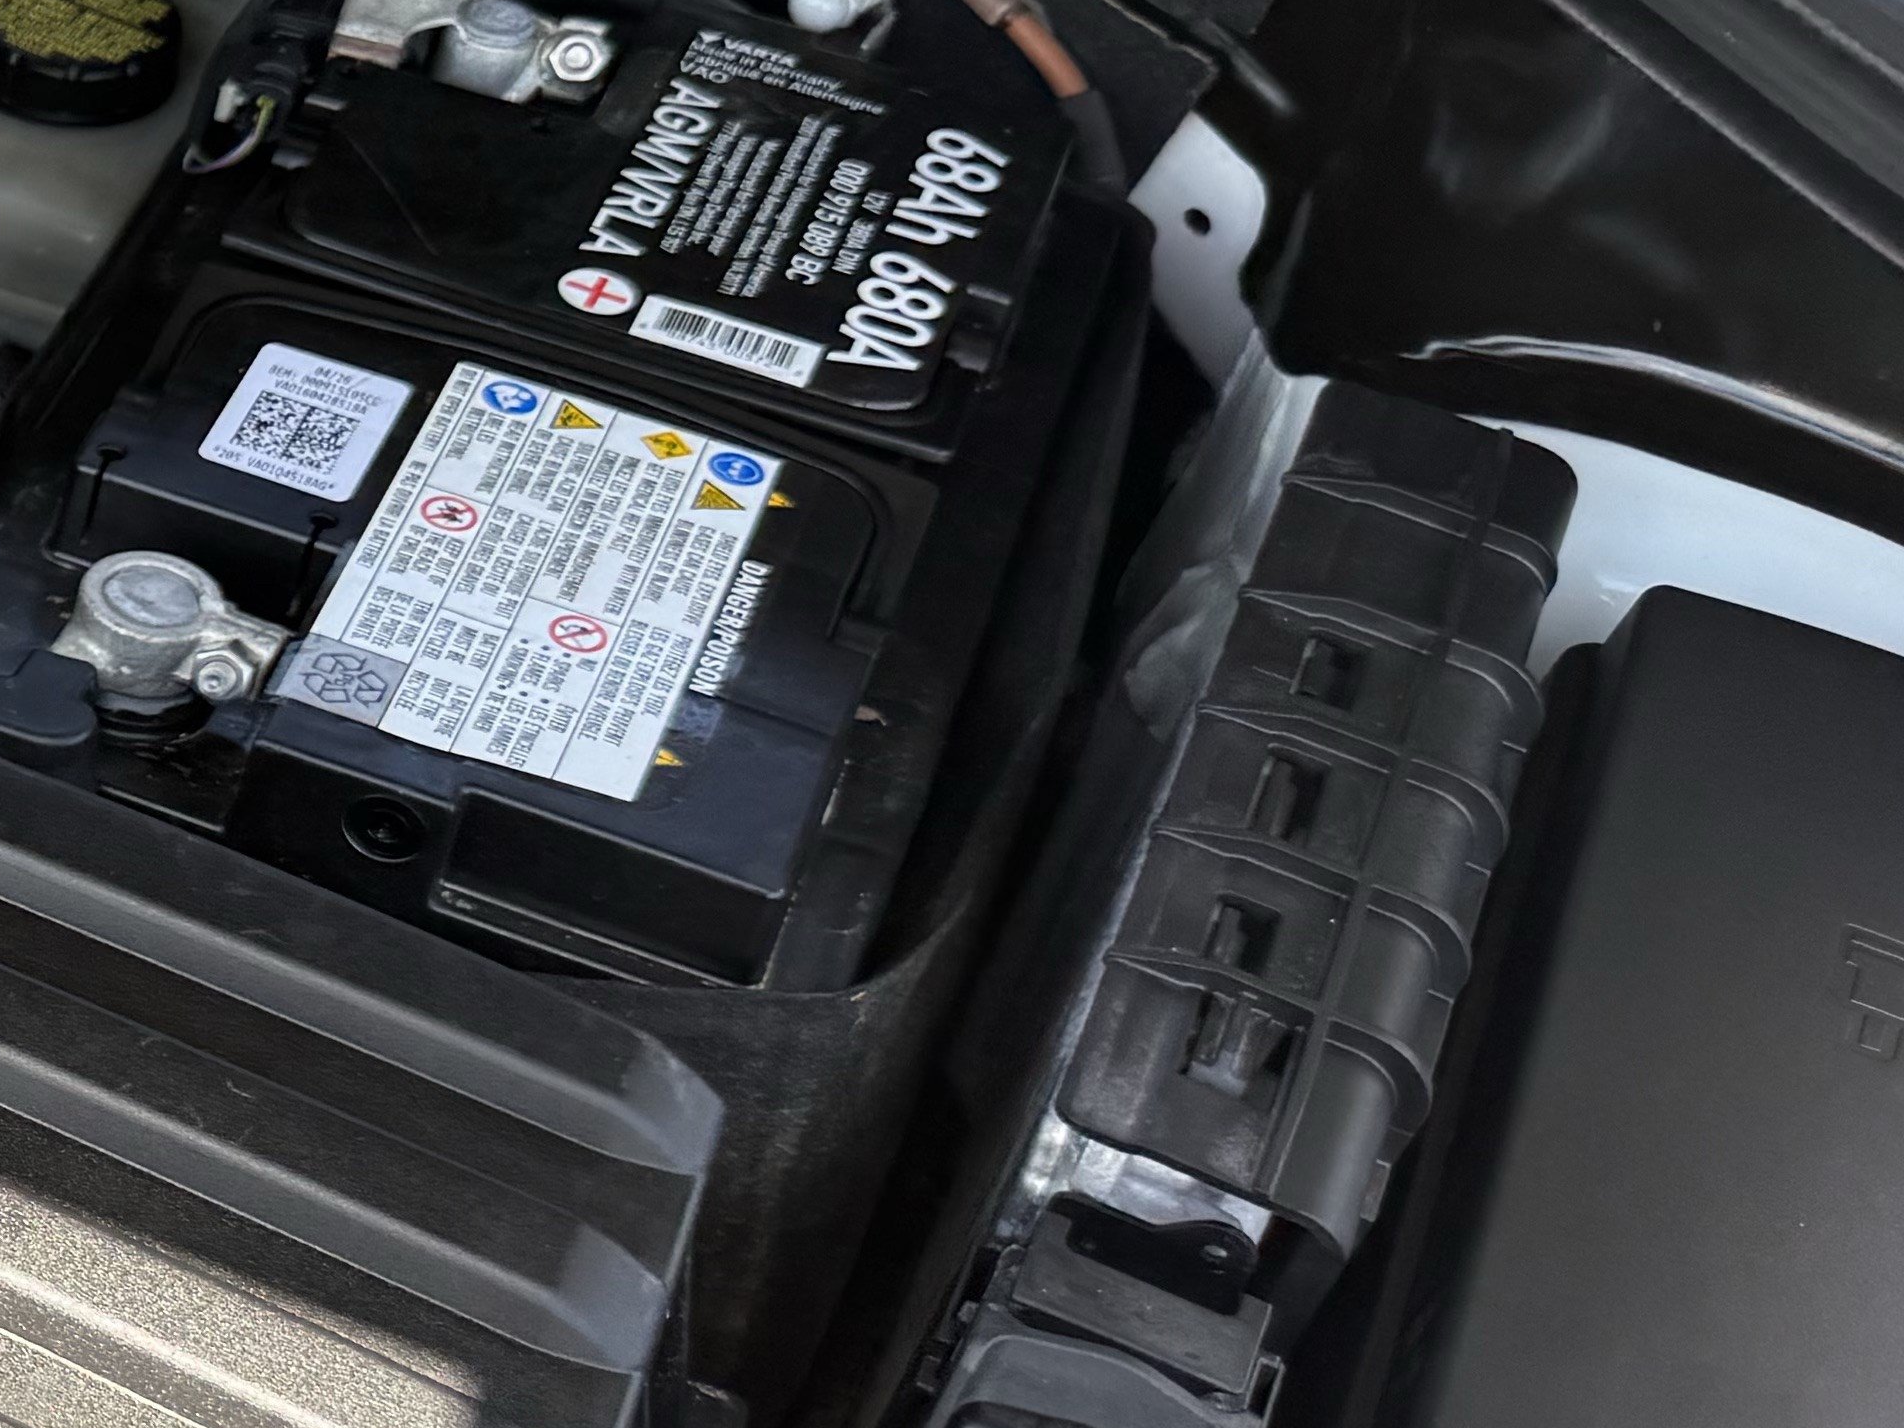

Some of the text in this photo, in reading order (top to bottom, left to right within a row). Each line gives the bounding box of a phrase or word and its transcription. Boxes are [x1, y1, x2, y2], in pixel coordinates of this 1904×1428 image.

[579, 77, 723, 258] AGM/VRLA
[782, 157, 872, 288] 000 915 089 BC
[826, 127, 1014, 372] 68Ah 680A
[409, 530, 447, 574] THE REACH
[424, 536, 467, 588] KEEP OUT OF
[669, 524, 717, 596] GASES CAN CAUSE
[349, 585, 395, 643] DES ENFANTS.
[369, 591, 414, 650] DE LA PORTÉE
[392, 598, 434, 647] TENIR HORS
[688, 558, 775, 698] DANGER/POISON
[418, 616, 457, 662] RECYCLED.
[443, 624, 479, 664] MUST BE
[466, 631, 501, 671] BATTERY
[657, 633, 697, 679] PROTÉGEZ
[392, 668, 434, 714] RECYCLÉE.
[518, 651, 551, 687] FLAMES
[540, 658, 572, 694] SPARKS
[600, 625, 671, 747] LES GAZ EXPLOSIFS PEUVENT
[651, 675, 675, 693] LES
[414, 677, 452, 722] DOIT ÊTRE
[432, 684, 474, 737] LA BATTERIE
[470, 690, 508, 734] DE FUMER
[546, 702, 580, 735] ÉVITER
[484, 696, 529, 756] LES FLAMMES
[504, 704, 551, 769] LES ÉTINCELLES
